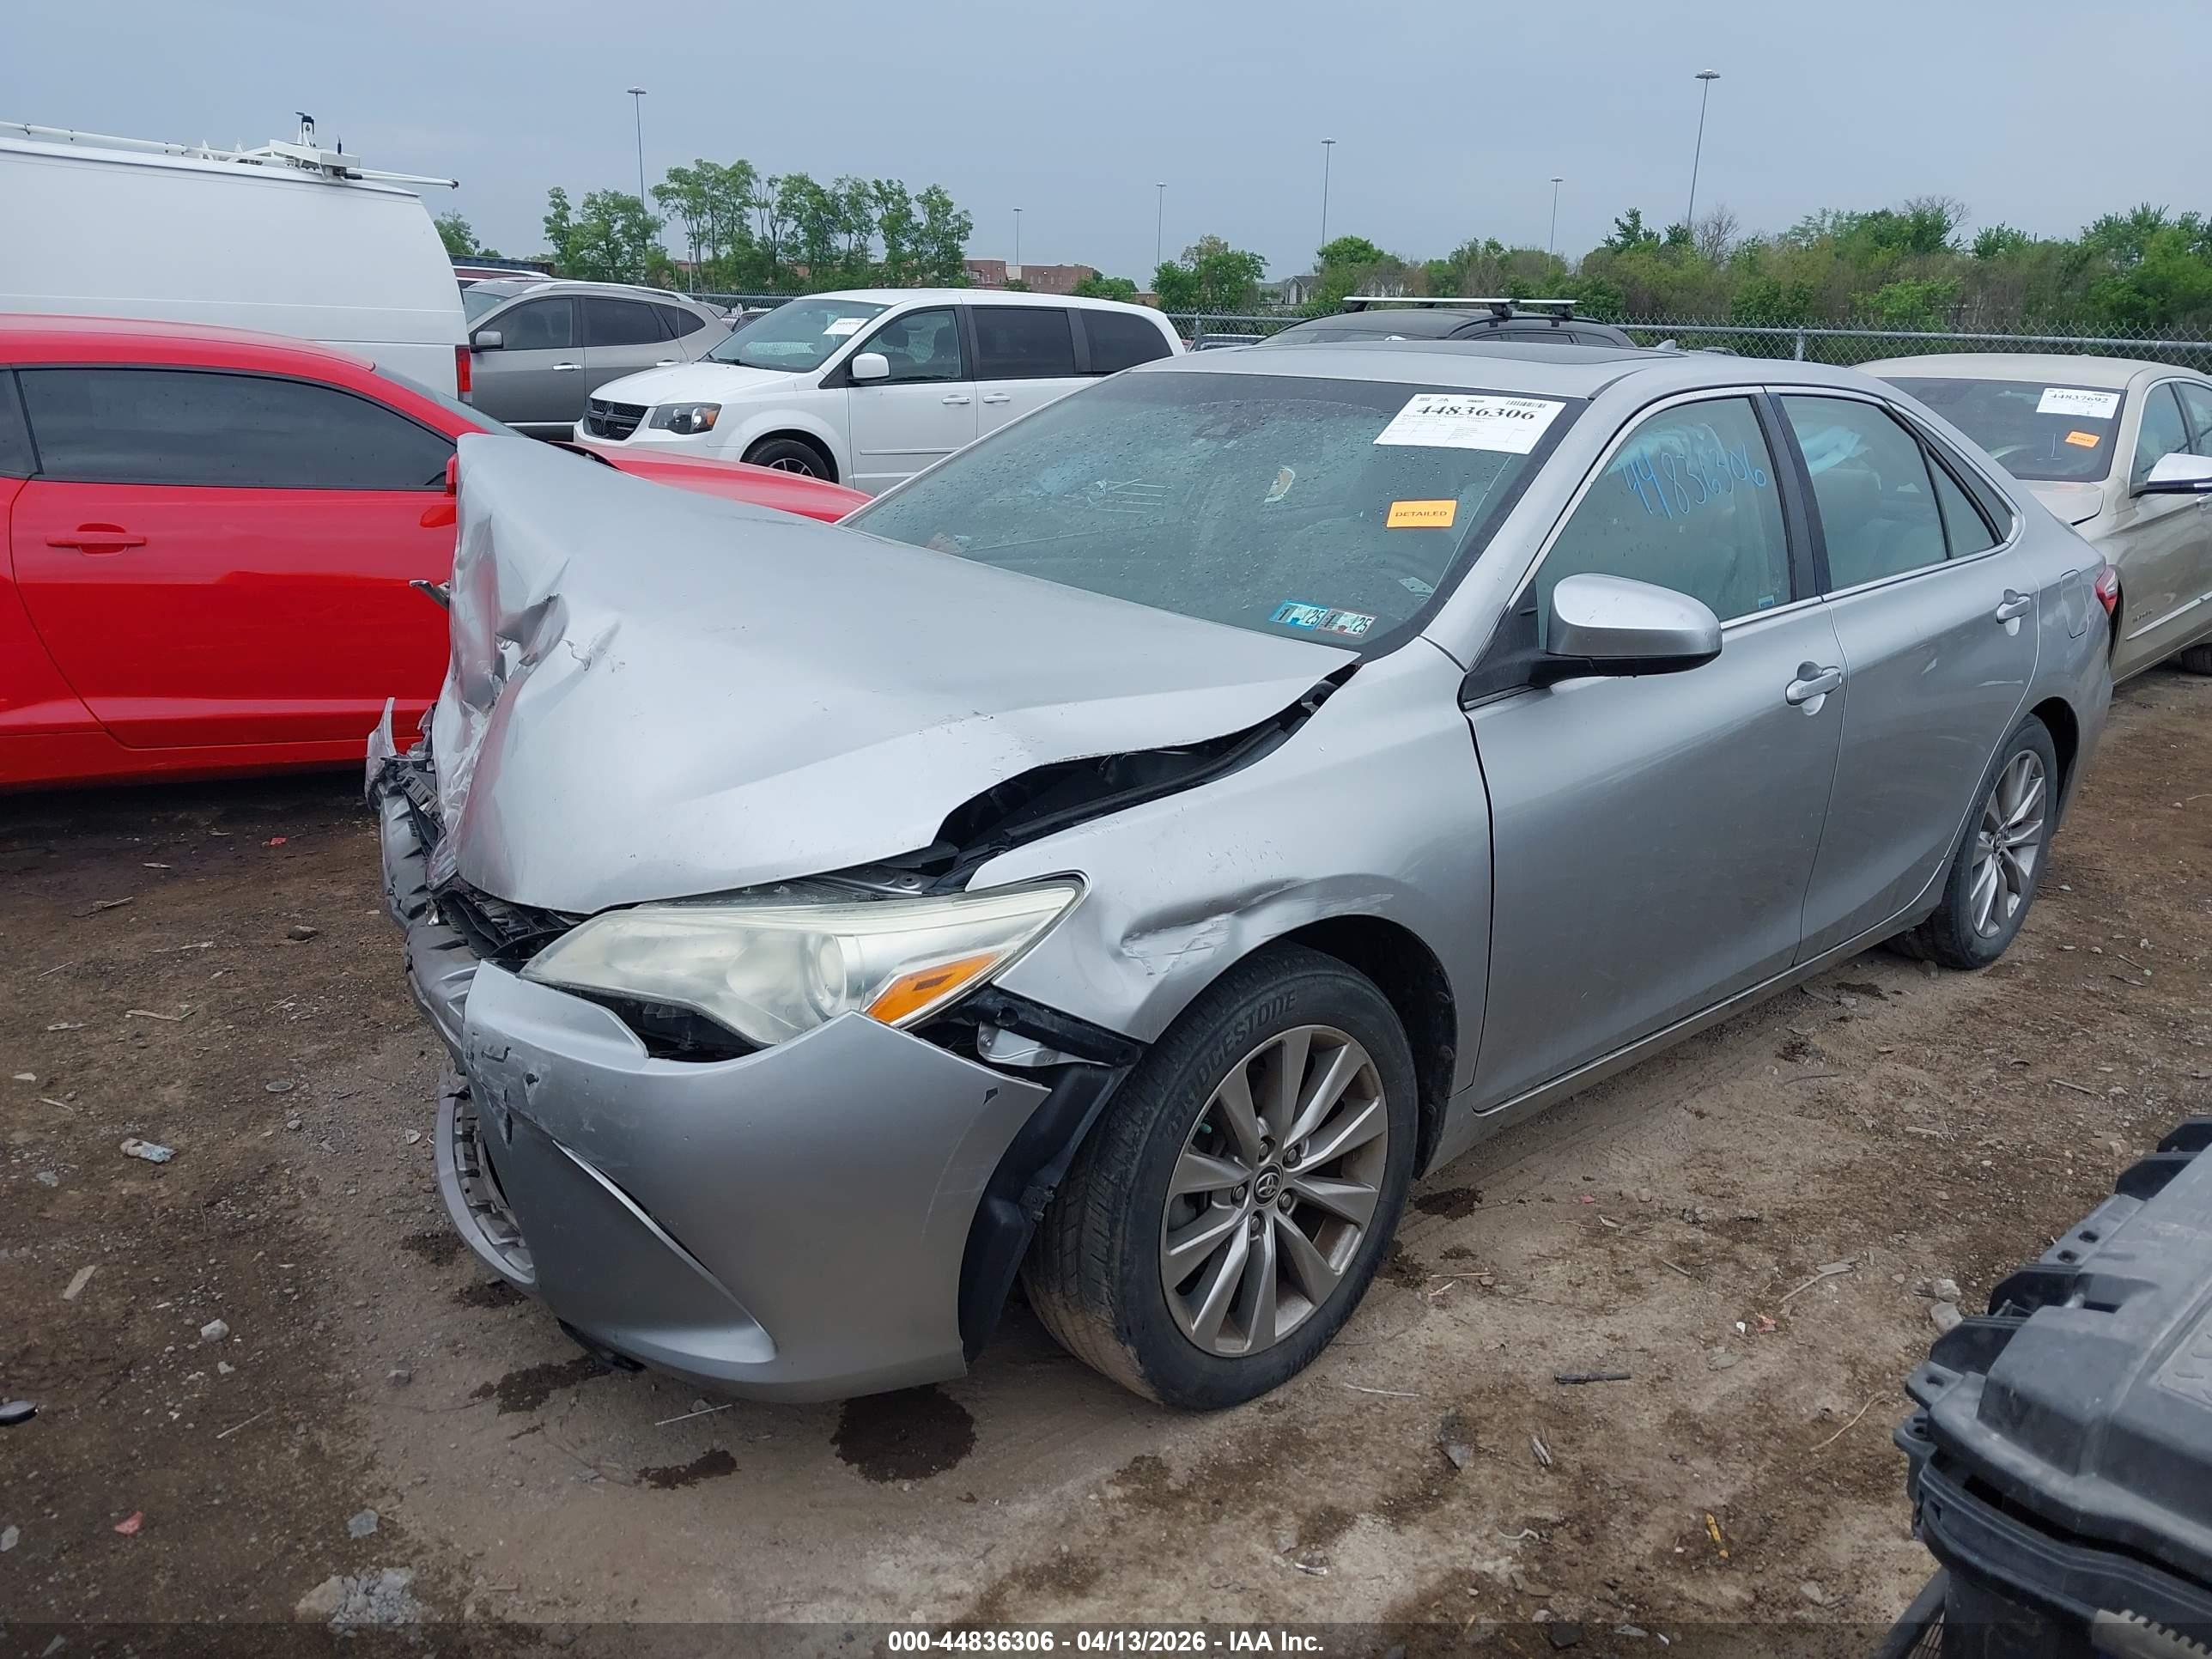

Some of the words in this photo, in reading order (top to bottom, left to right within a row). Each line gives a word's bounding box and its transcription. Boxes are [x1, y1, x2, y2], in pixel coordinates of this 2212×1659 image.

[1416, 404, 1536, 421] 44836306
[1621, 443, 1767, 520] 44836306
[1305, 609, 1326, 625] 25
[1352, 617, 1372, 633] 25
[1165, 992, 1297, 1136] BRIDGESTONE
